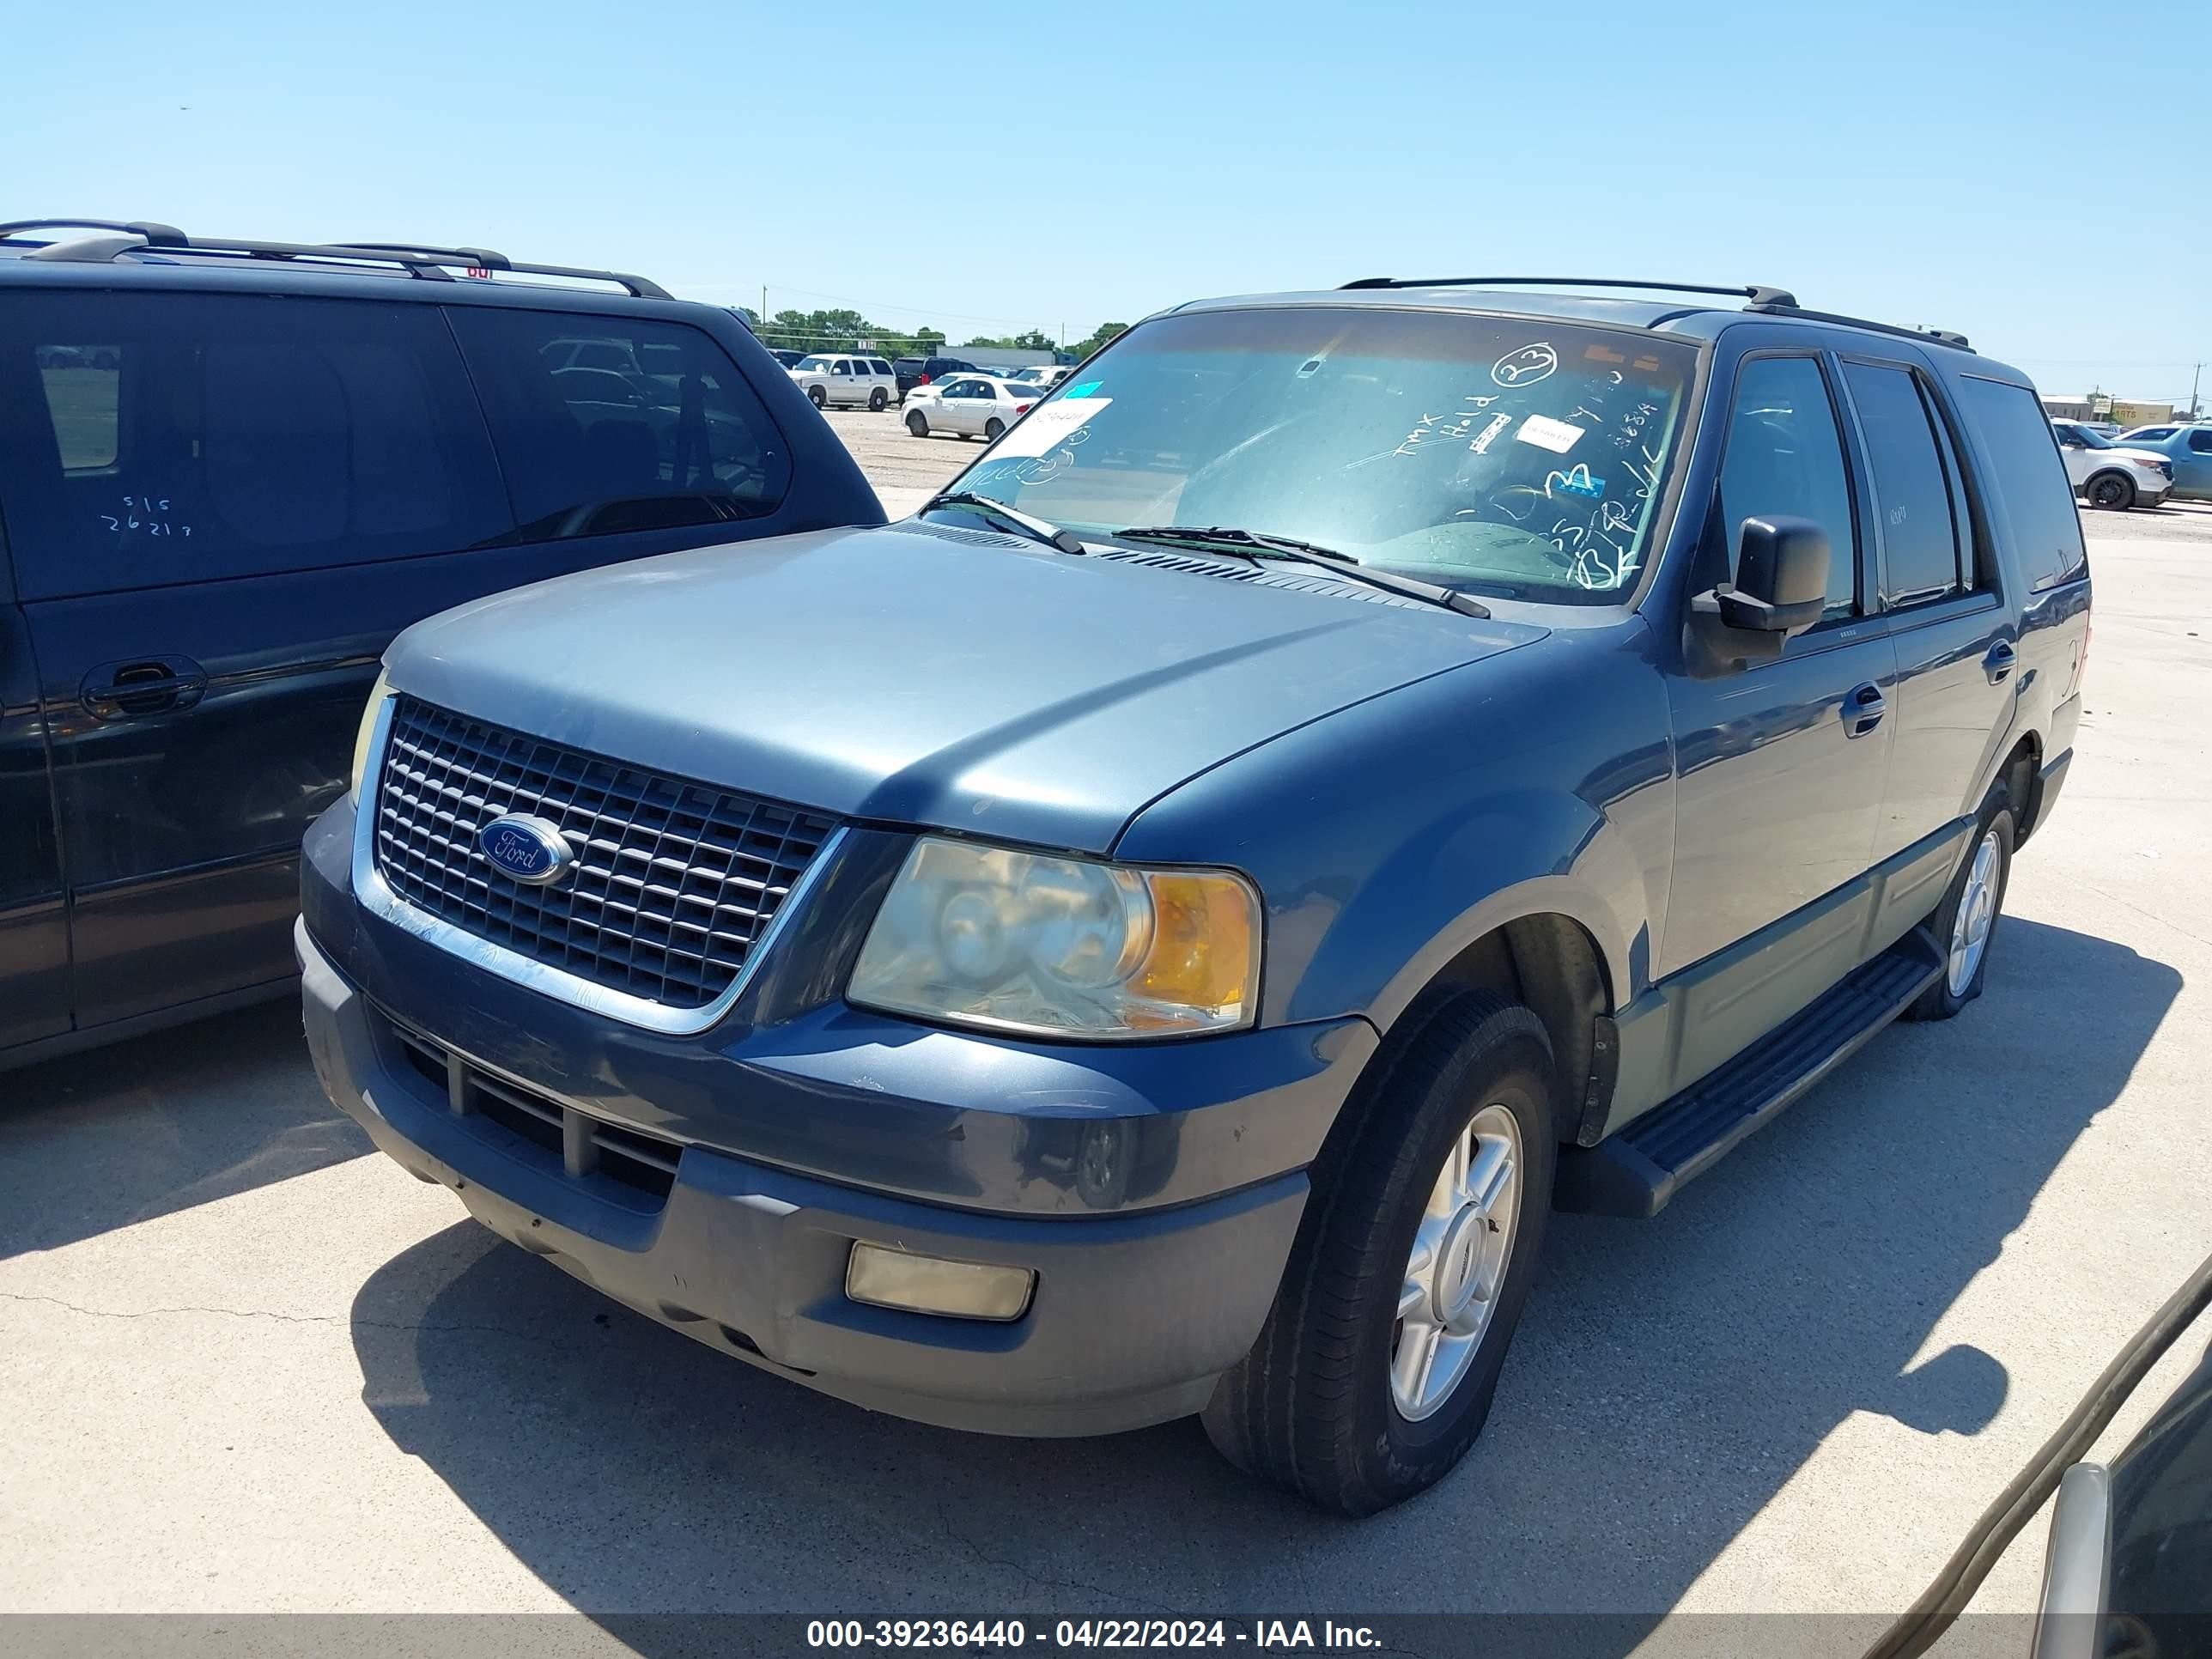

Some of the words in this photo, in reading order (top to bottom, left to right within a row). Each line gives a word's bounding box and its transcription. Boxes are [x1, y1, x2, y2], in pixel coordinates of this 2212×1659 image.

[1499, 349, 1553, 381] 23
[1439, 395, 1499, 438] Hold
[495, 830, 539, 869] Ford
